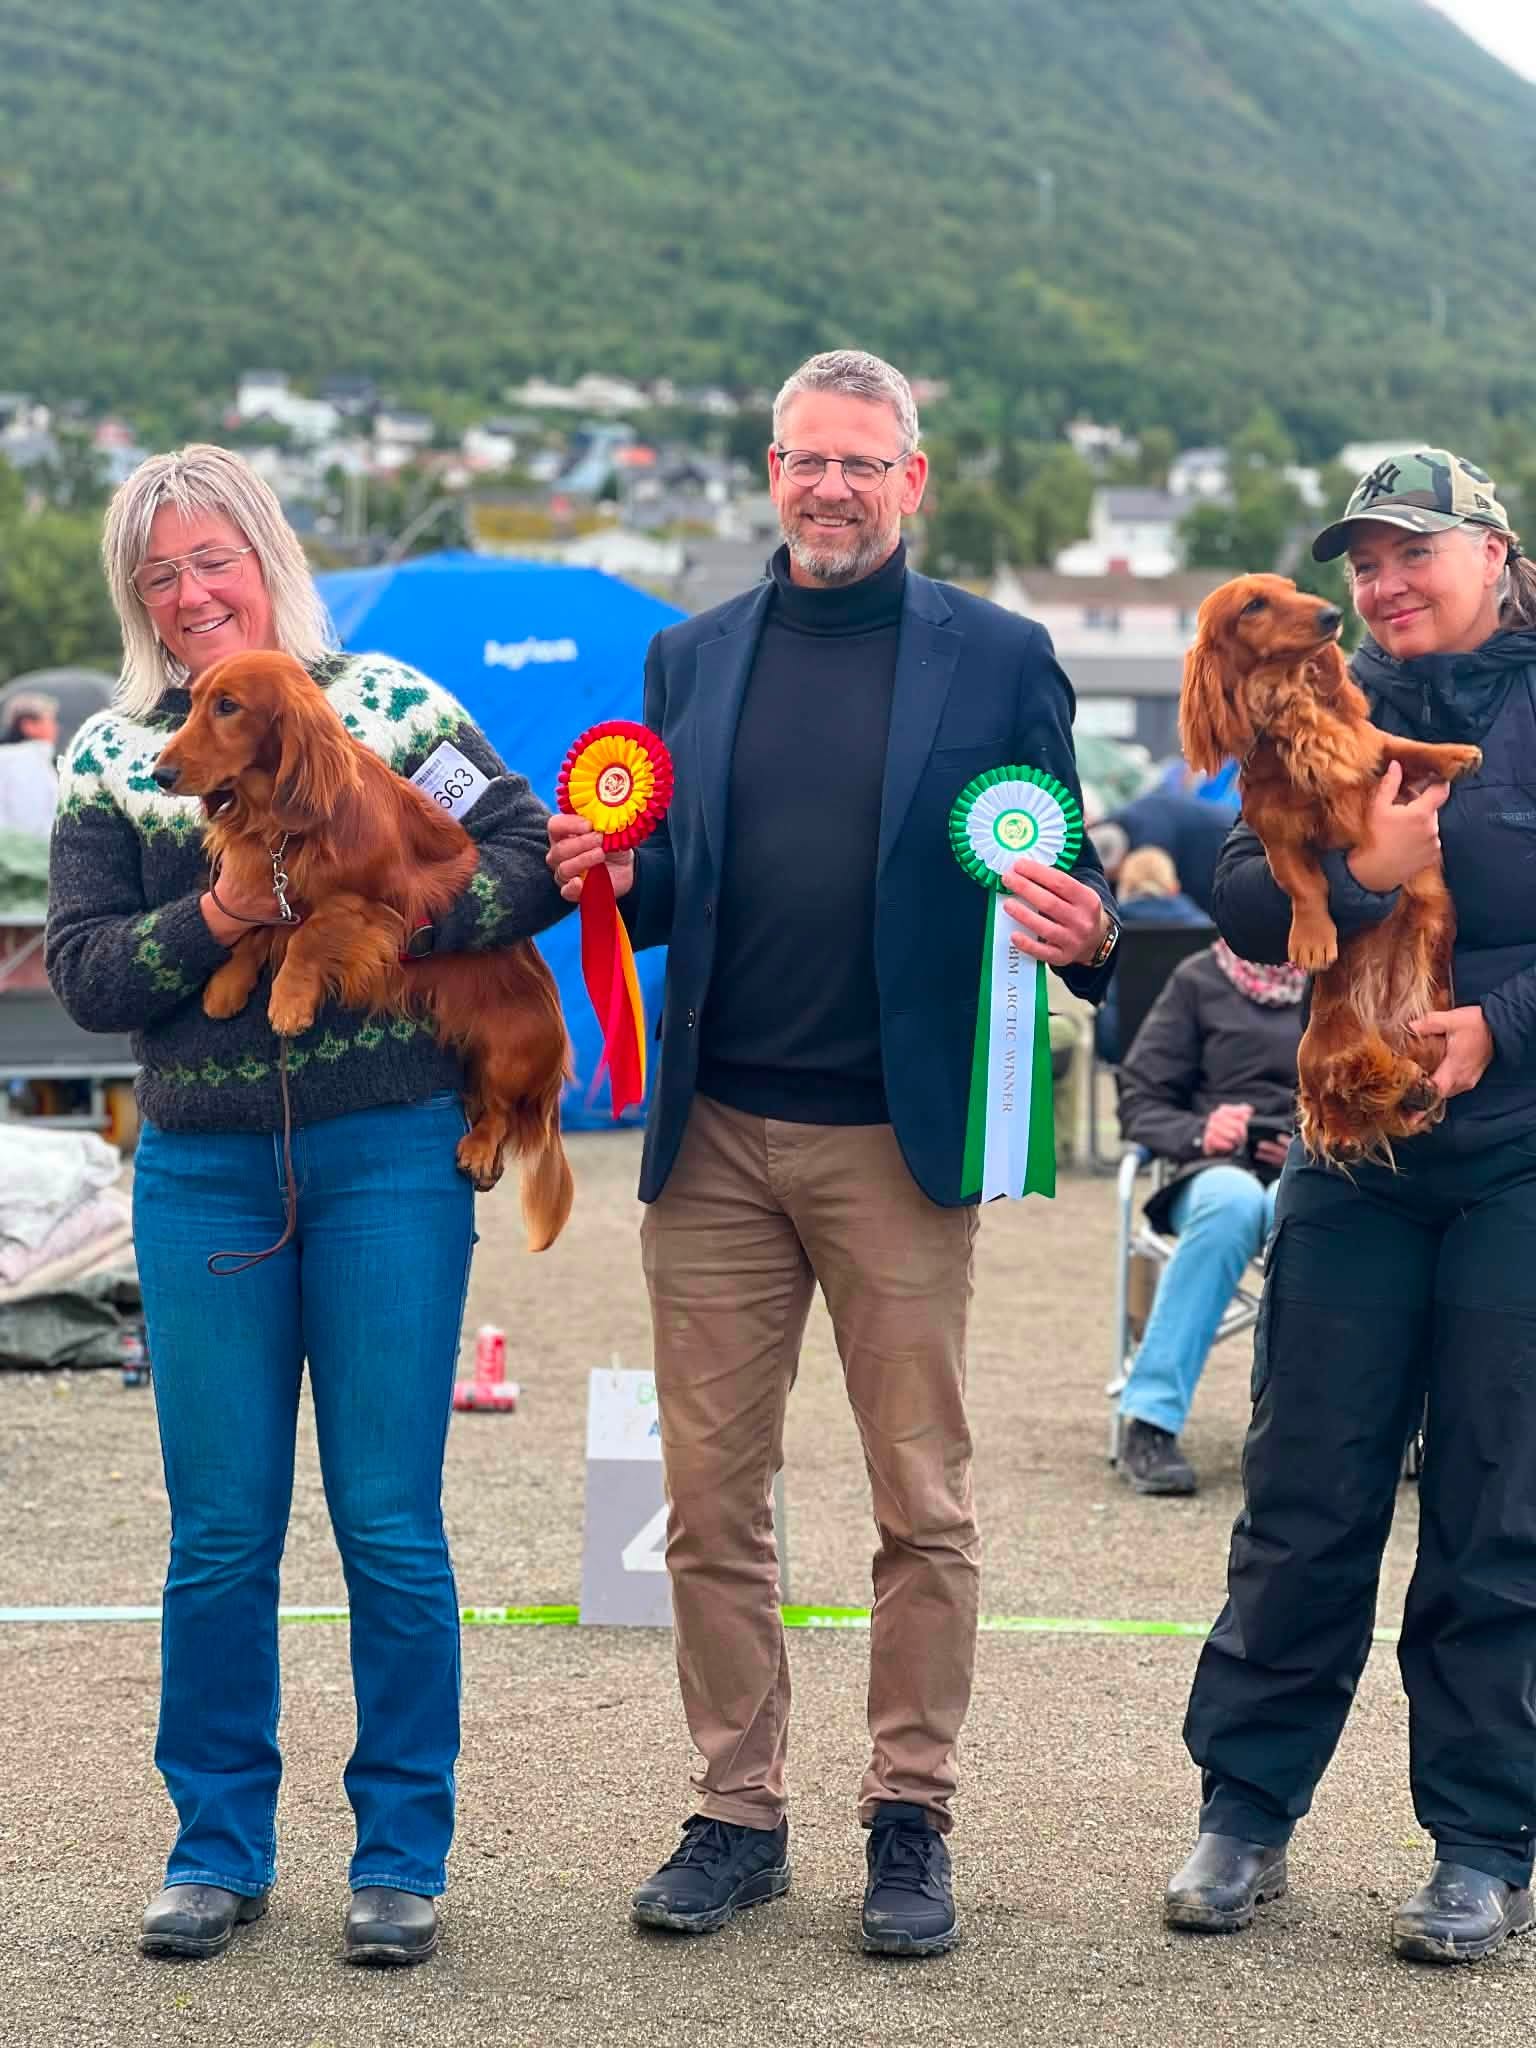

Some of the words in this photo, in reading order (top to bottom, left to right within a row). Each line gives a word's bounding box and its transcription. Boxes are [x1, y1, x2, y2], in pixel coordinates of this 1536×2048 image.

[1359, 463, 1400, 502] NY
[434, 768, 474, 809] 663
[1006, 982, 1018, 1040] ARCTIC
[1002, 1050, 1016, 1112] WINNER
